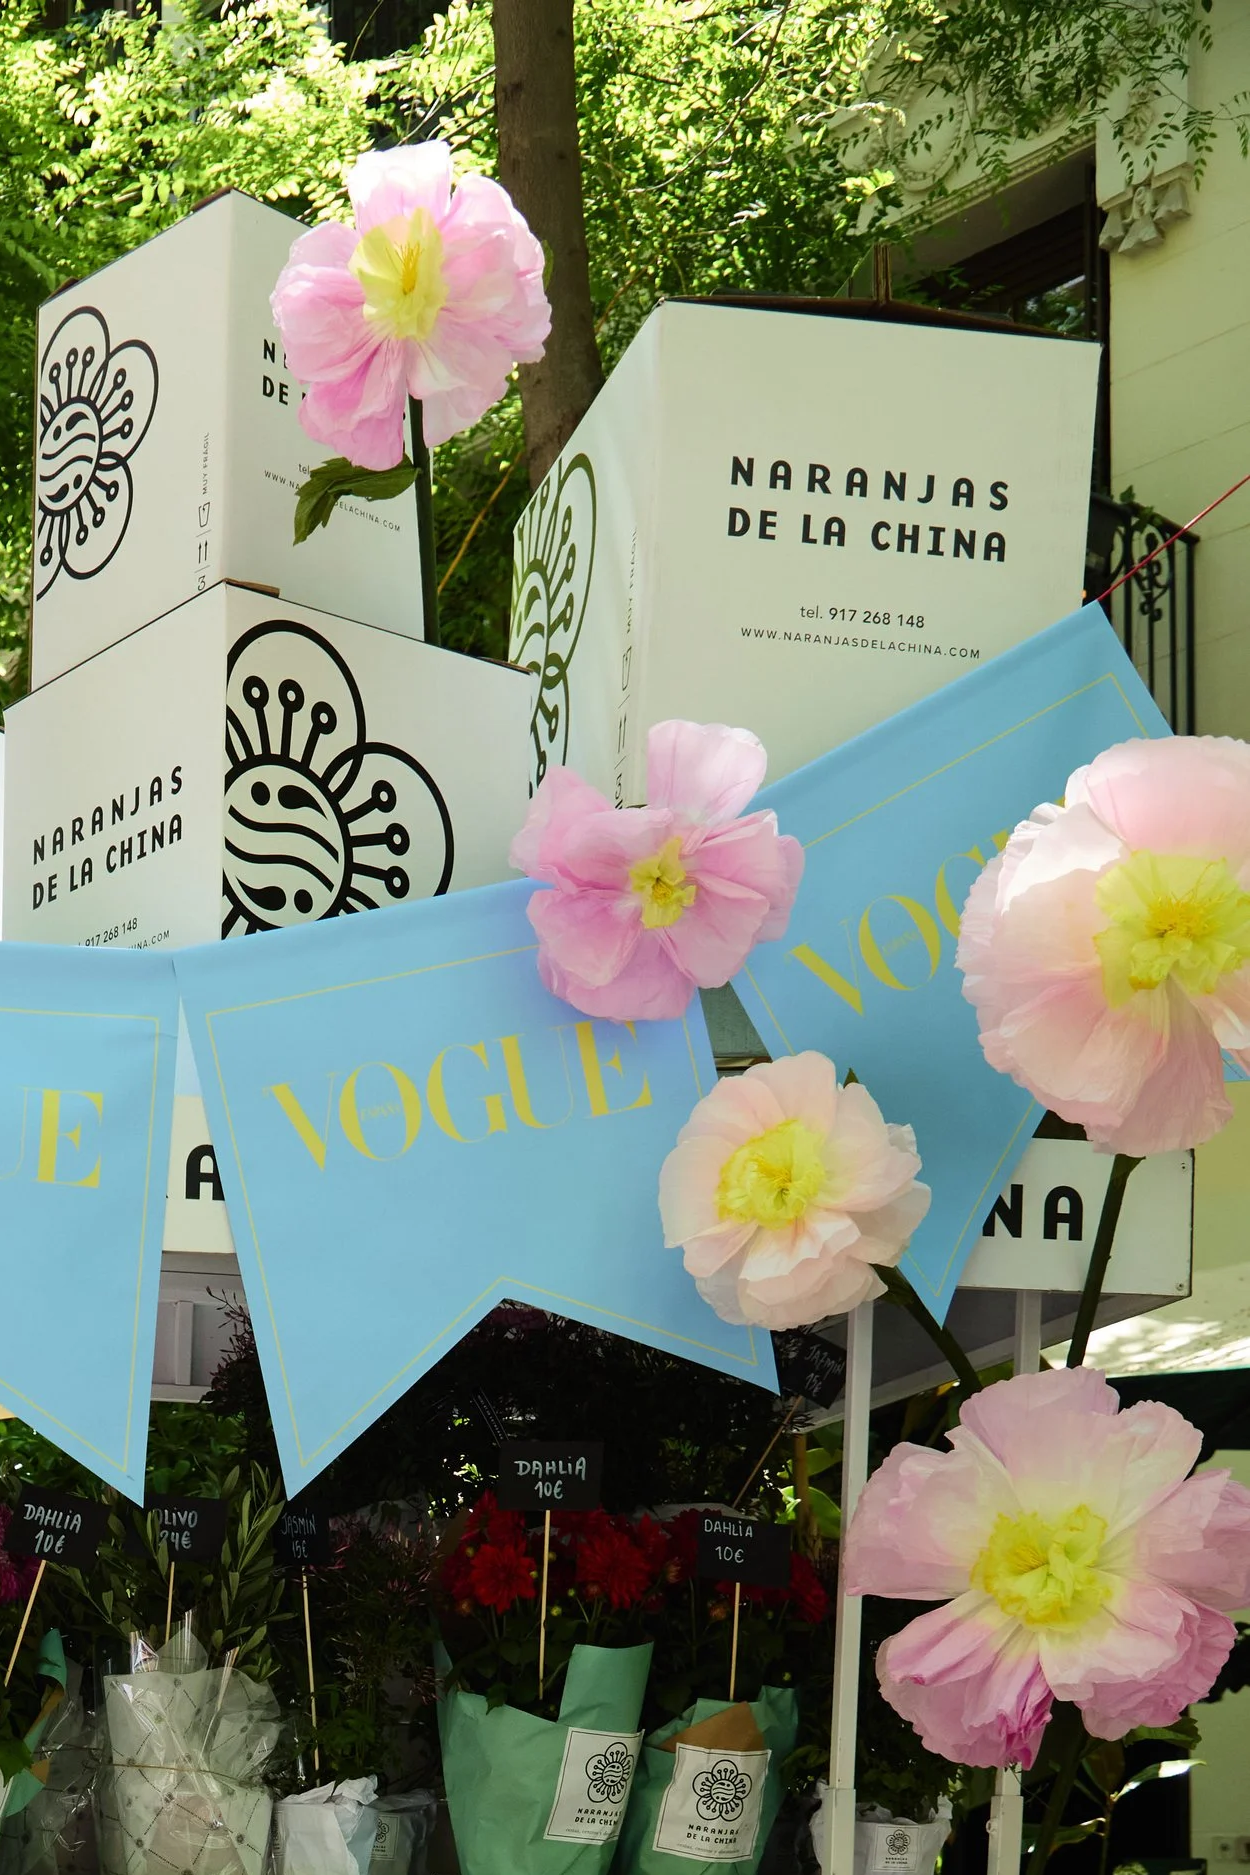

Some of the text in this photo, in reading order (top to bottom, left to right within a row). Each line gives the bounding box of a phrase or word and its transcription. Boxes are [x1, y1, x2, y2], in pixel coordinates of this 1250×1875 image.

[262, 375, 289, 406] DE
[730, 455, 1009, 511] NARANJAS
[727, 506, 1006, 563] DE LA CHINA
[800, 605, 925, 629] tel. 917 268 148
[740, 627, 981, 660] WWW.NARANJASDELACHINA.COM
[33, 765, 183, 866] NARANJAS
[32, 813, 182, 911] DE LA CHINA
[103, 926, 119, 943] 268
[122, 917, 138, 935] 148
[262, 1020, 653, 1172] VOGUE
[534, 1480, 563, 1499] 10€
[34, 1529, 66, 1555] 10€
[292, 1540, 308, 1559] 15€
[715, 1546, 745, 1563] 10€
[575, 1816, 619, 1826] DE LA CHIN
[688, 1824, 739, 1836] NARANJAS
[686, 1832, 737, 1845] DE LA CHINA
